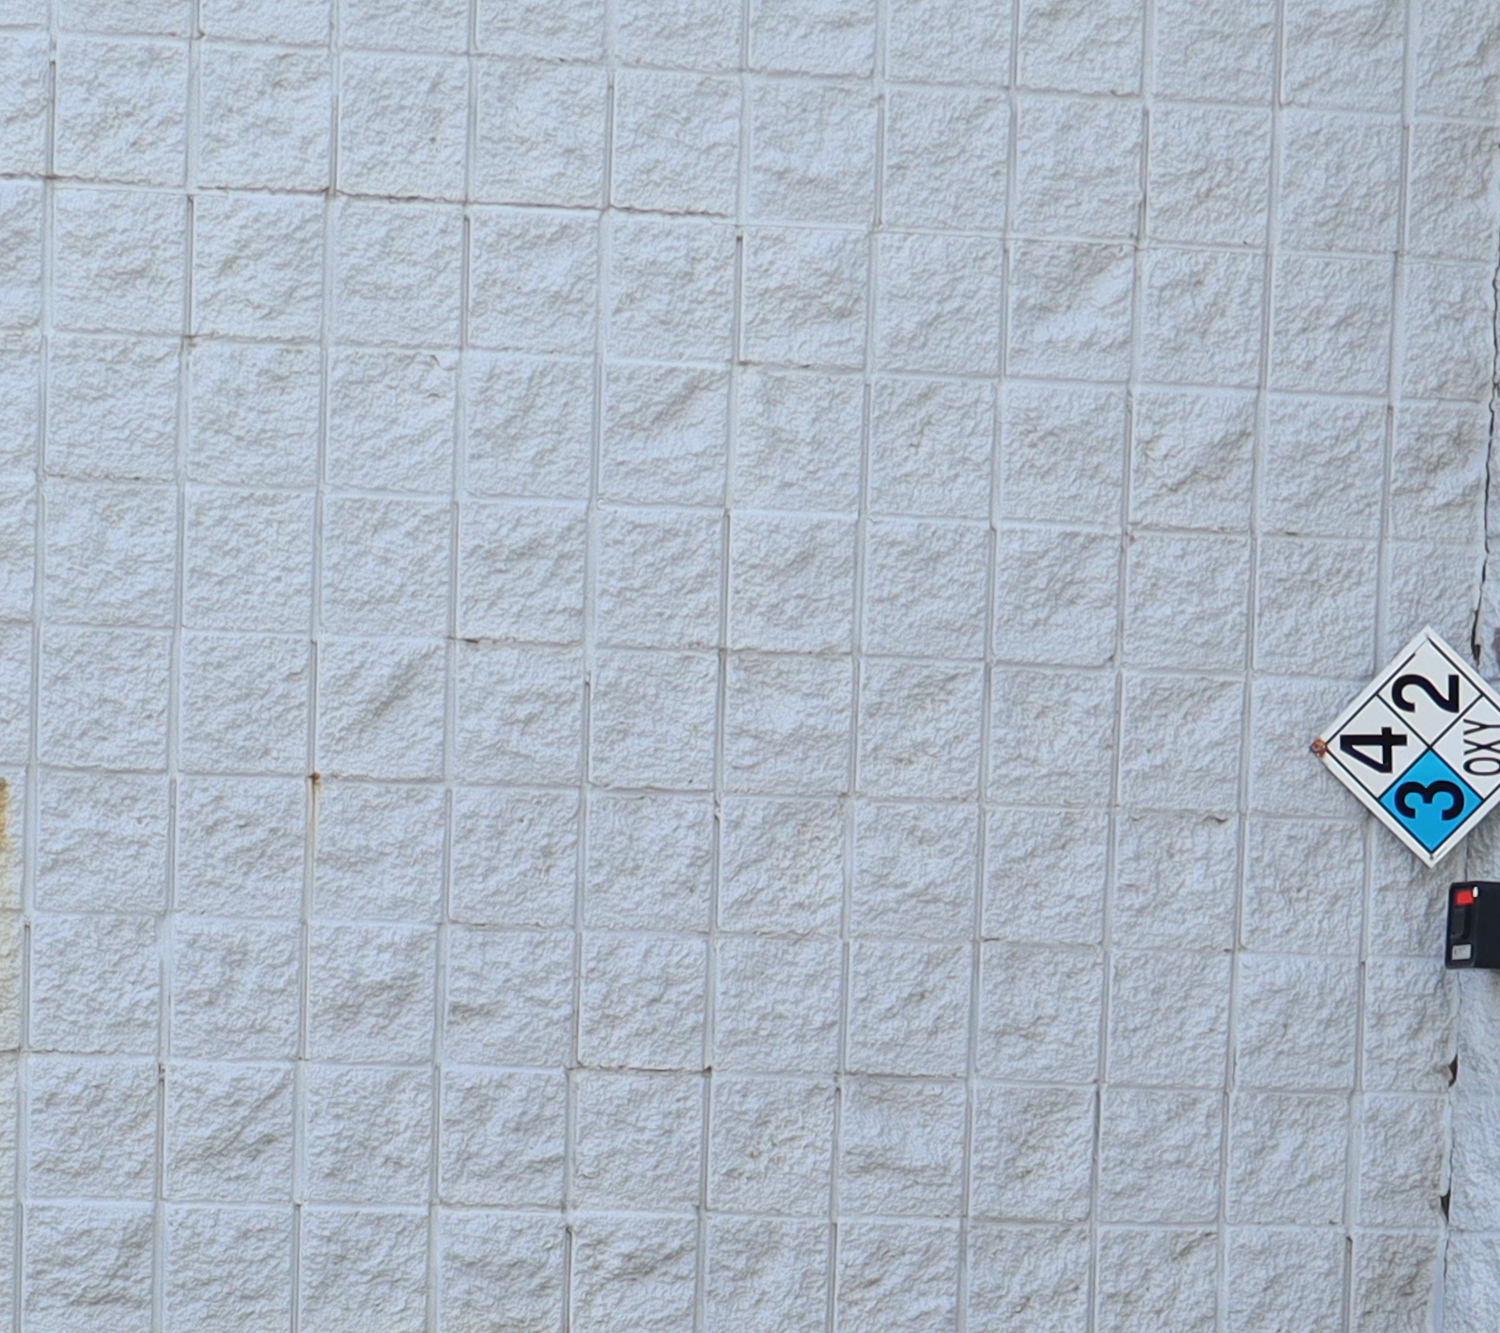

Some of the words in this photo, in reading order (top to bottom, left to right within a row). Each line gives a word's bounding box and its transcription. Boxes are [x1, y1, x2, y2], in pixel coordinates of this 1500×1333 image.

[1391, 673, 1460, 713] 2
[1339, 726, 1408, 774] 4
[1394, 780, 1466, 822] 3
